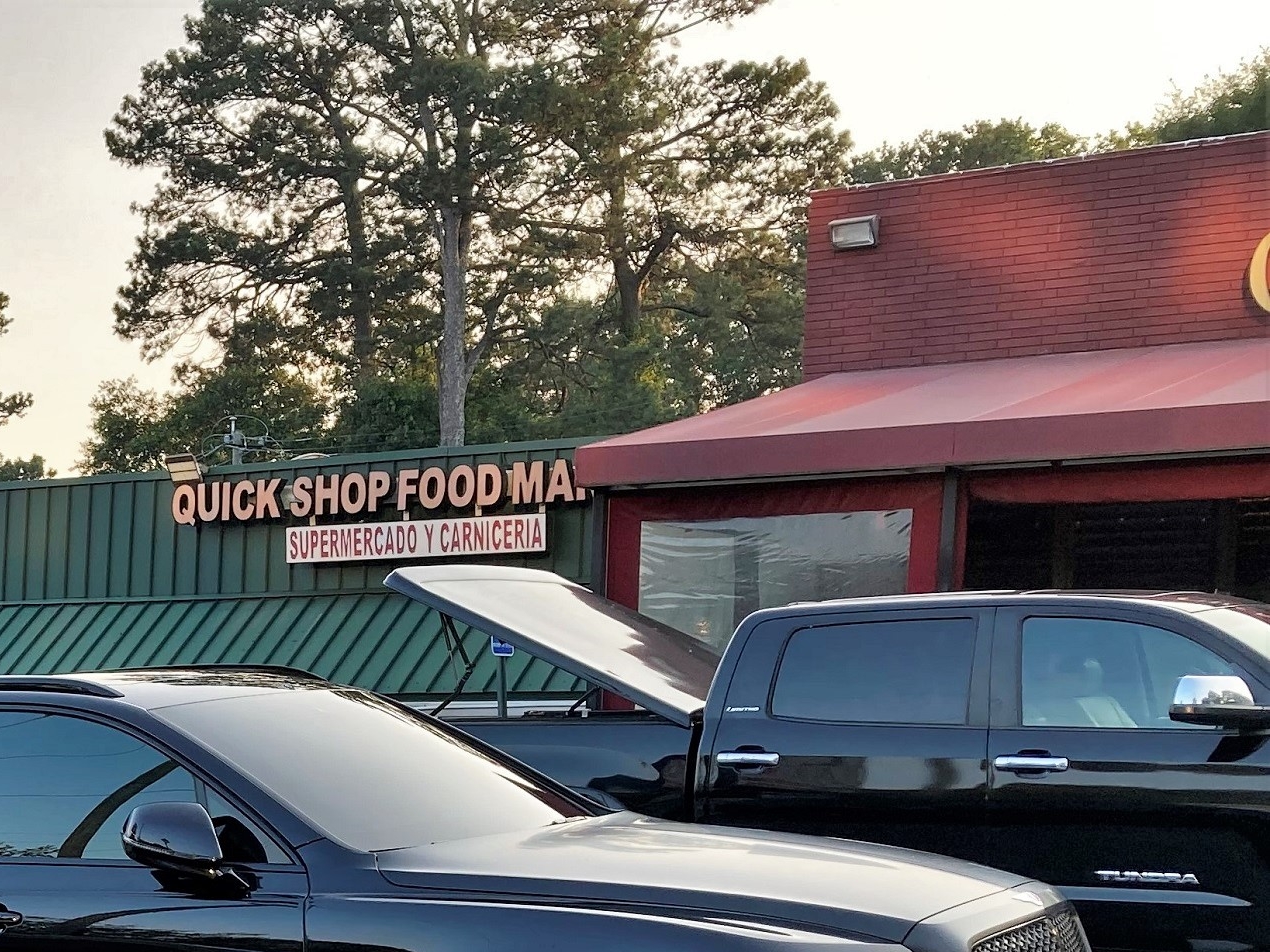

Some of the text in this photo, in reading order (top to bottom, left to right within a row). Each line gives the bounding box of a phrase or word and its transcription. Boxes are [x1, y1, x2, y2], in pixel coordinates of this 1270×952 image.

[172, 478, 282, 526] QUICK
[290, 471, 391, 518] SHOP
[397, 463, 502, 511] FOOD
[289, 513, 543, 560] SUPERMERCADO Y CARNICERIA
